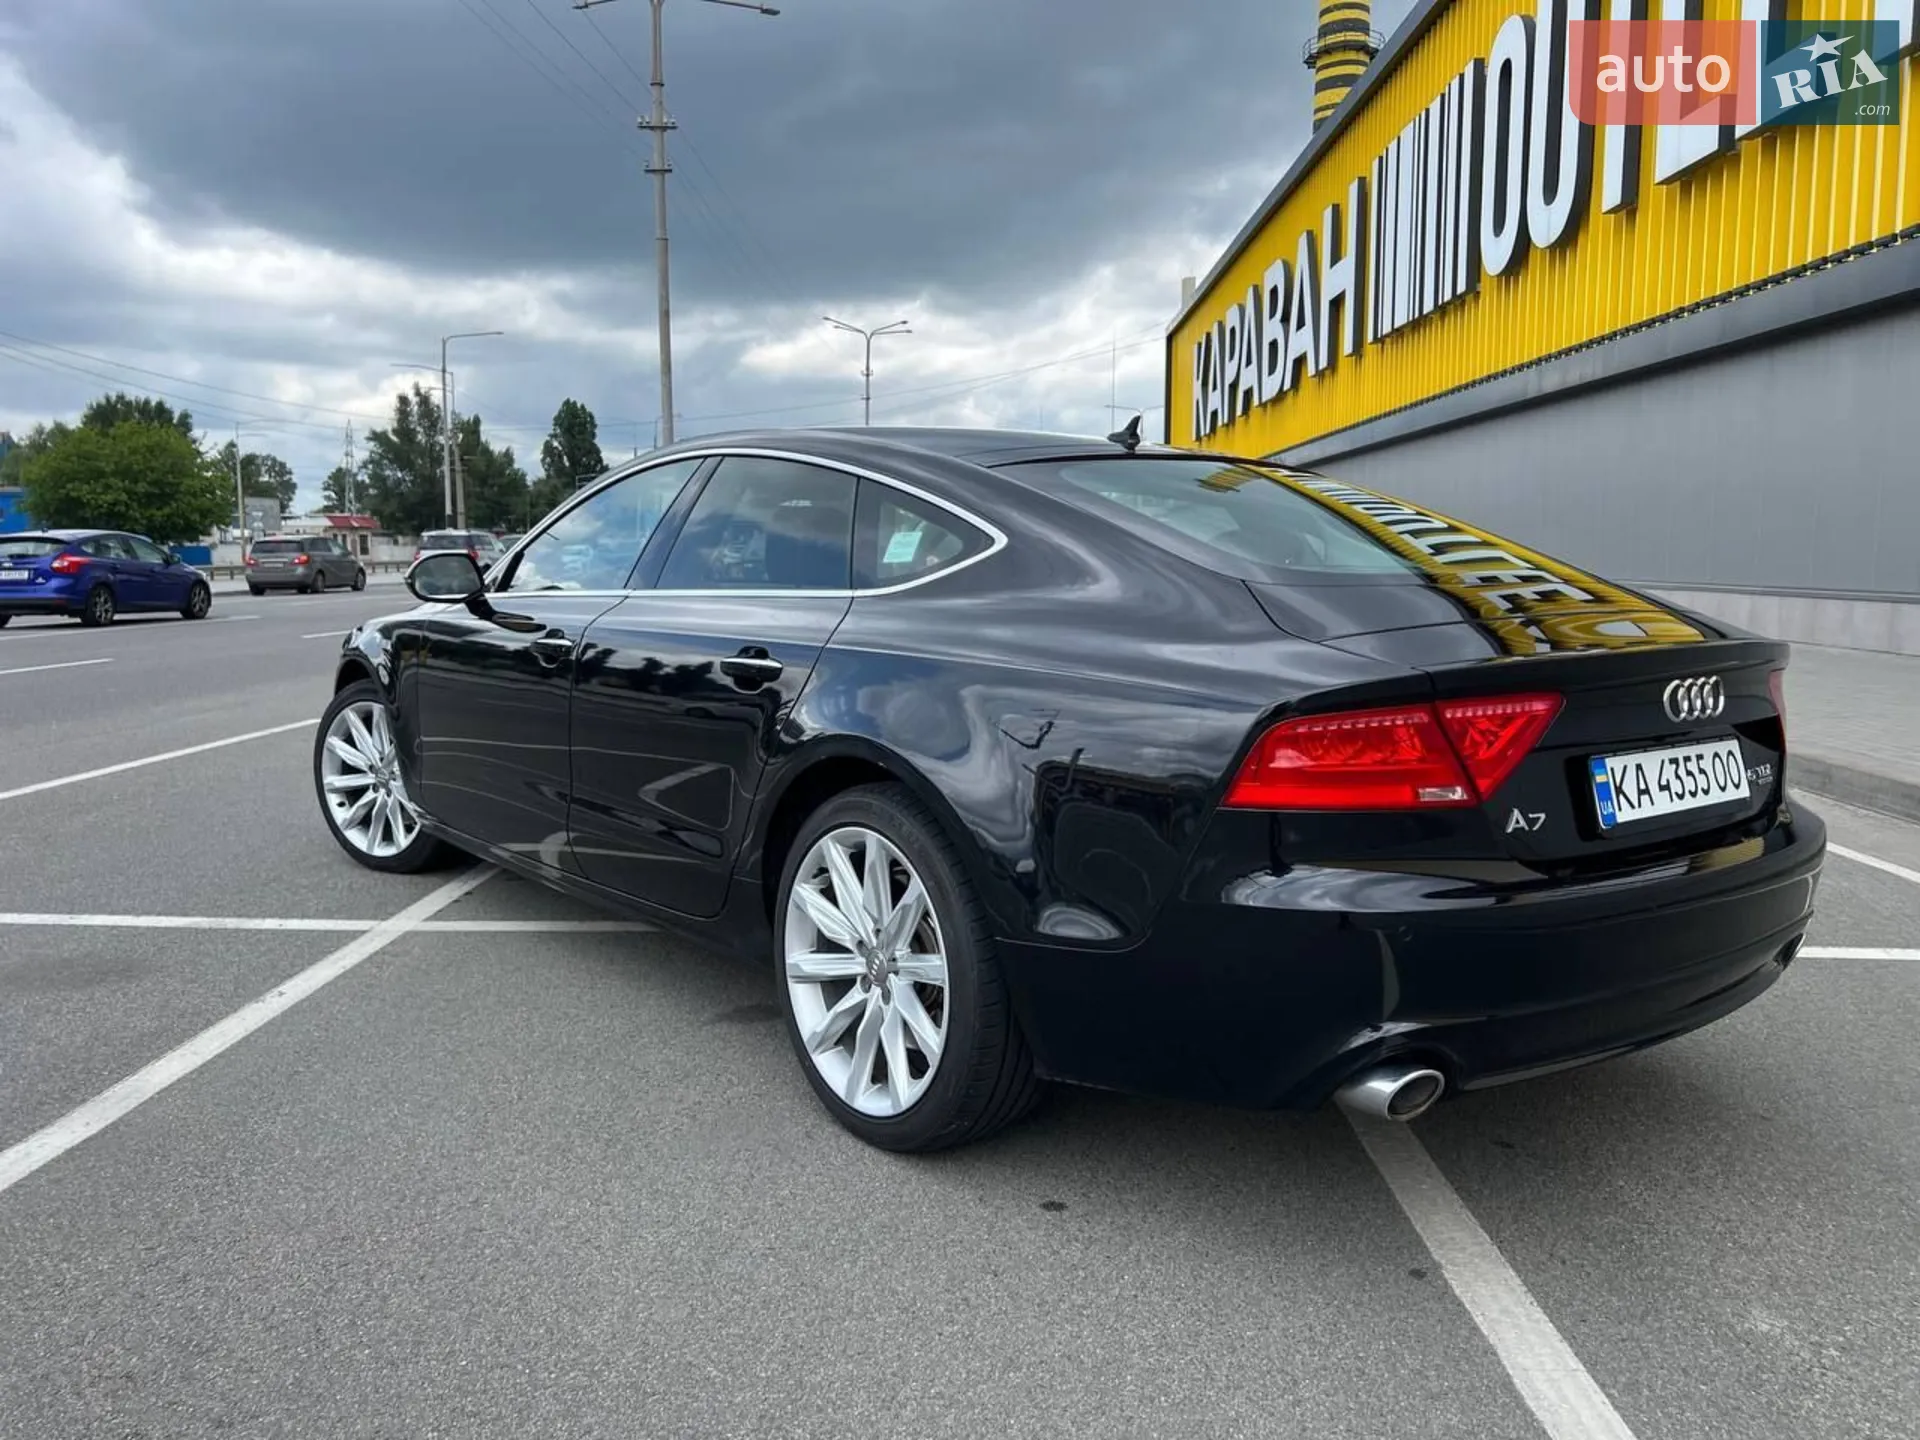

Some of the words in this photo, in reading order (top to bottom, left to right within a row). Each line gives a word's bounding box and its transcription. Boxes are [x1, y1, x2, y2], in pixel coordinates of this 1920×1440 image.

[1192, 176, 1365, 442] КАРАВАН
[1506, 807, 1546, 833] A7
[1600, 800, 1616, 816] UA
